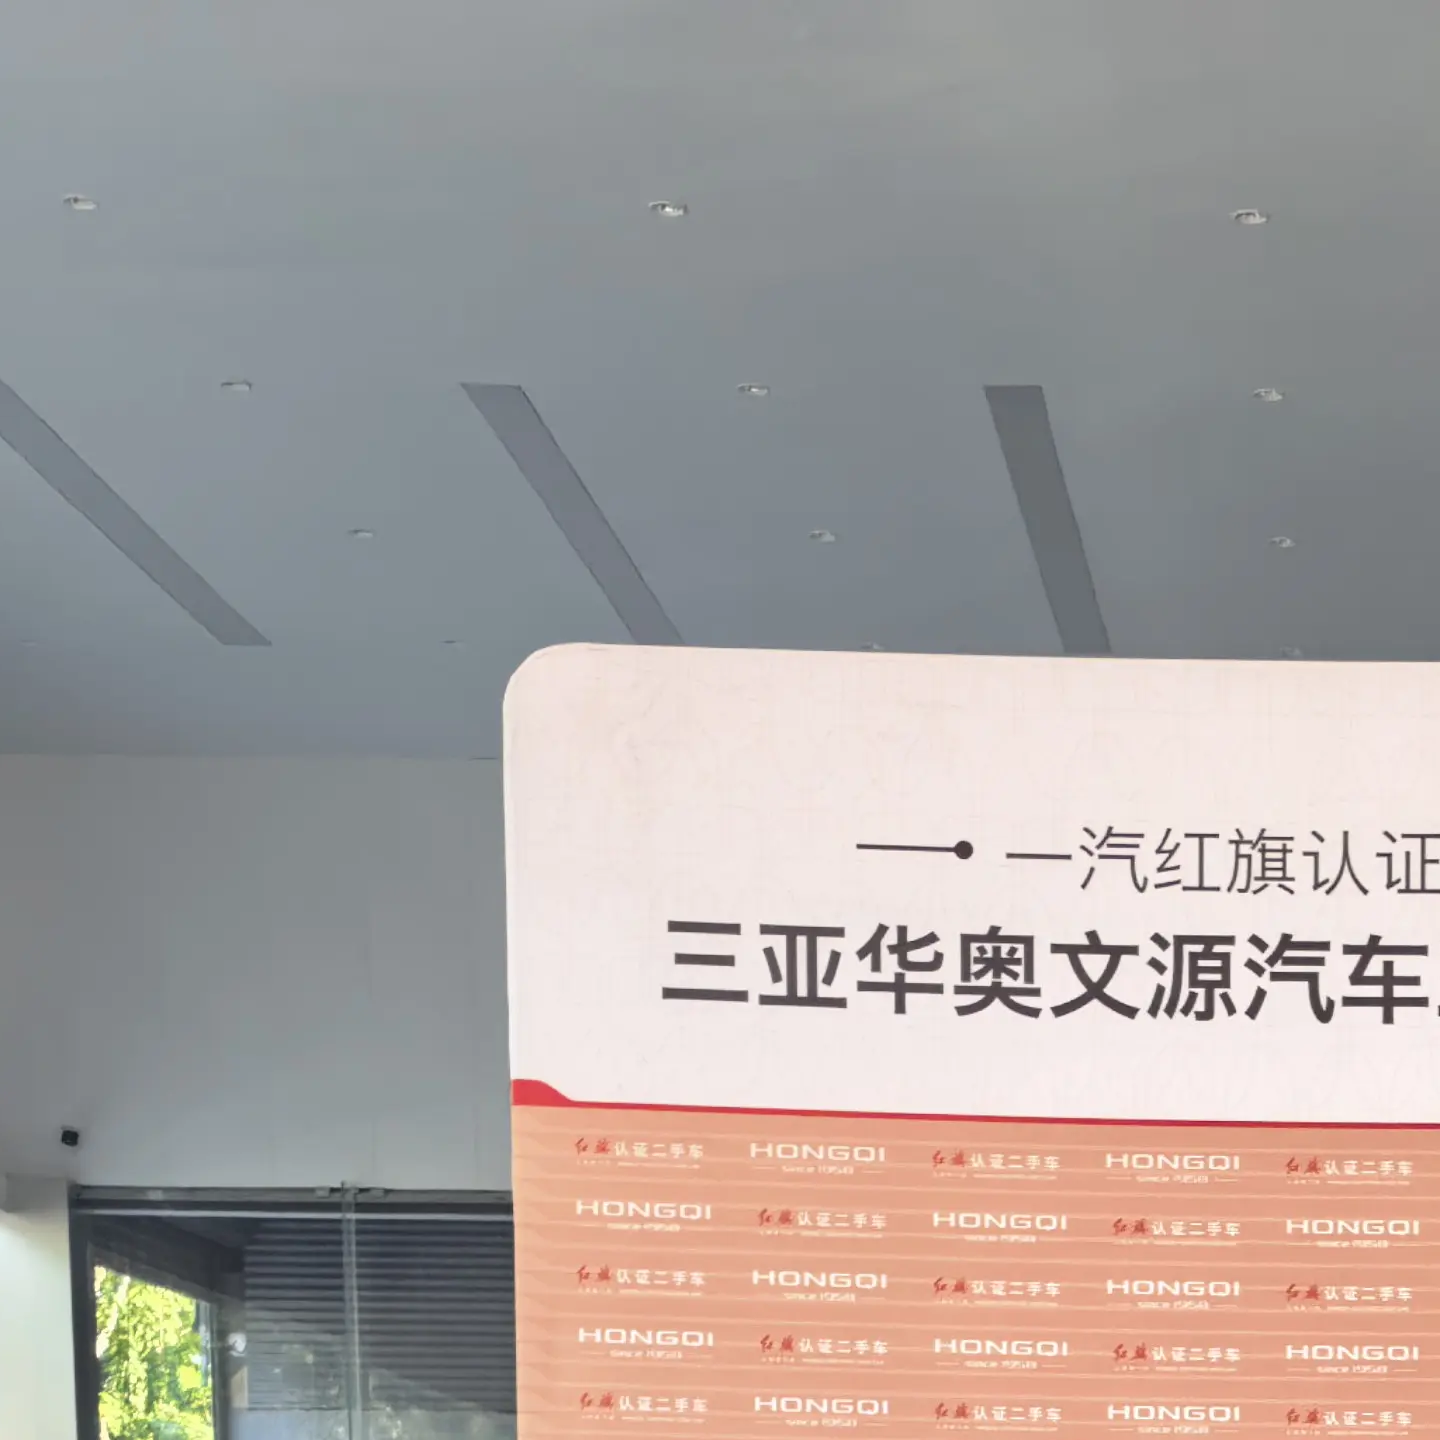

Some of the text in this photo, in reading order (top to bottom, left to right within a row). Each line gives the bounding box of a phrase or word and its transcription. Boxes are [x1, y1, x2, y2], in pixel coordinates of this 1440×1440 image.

[751, 1143, 886, 1162] HONGQI
[1106, 1154, 1241, 1171] HONGQI
[577, 1200, 712, 1220] HONGQI
[933, 1212, 1068, 1231] HONGQI
[1286, 1219, 1421, 1236] HONGQI
[752, 1270, 888, 1289] HONGQI
[1106, 1279, 1241, 1297] HONGQI
[578, 1328, 715, 1347] HONGQI
[934, 1338, 1069, 1357] HONGQI
[1286, 1344, 1420, 1361] HONGQI
[754, 1396, 890, 1416] HONGQI
[1108, 1405, 1241, 1422] HONGQI
